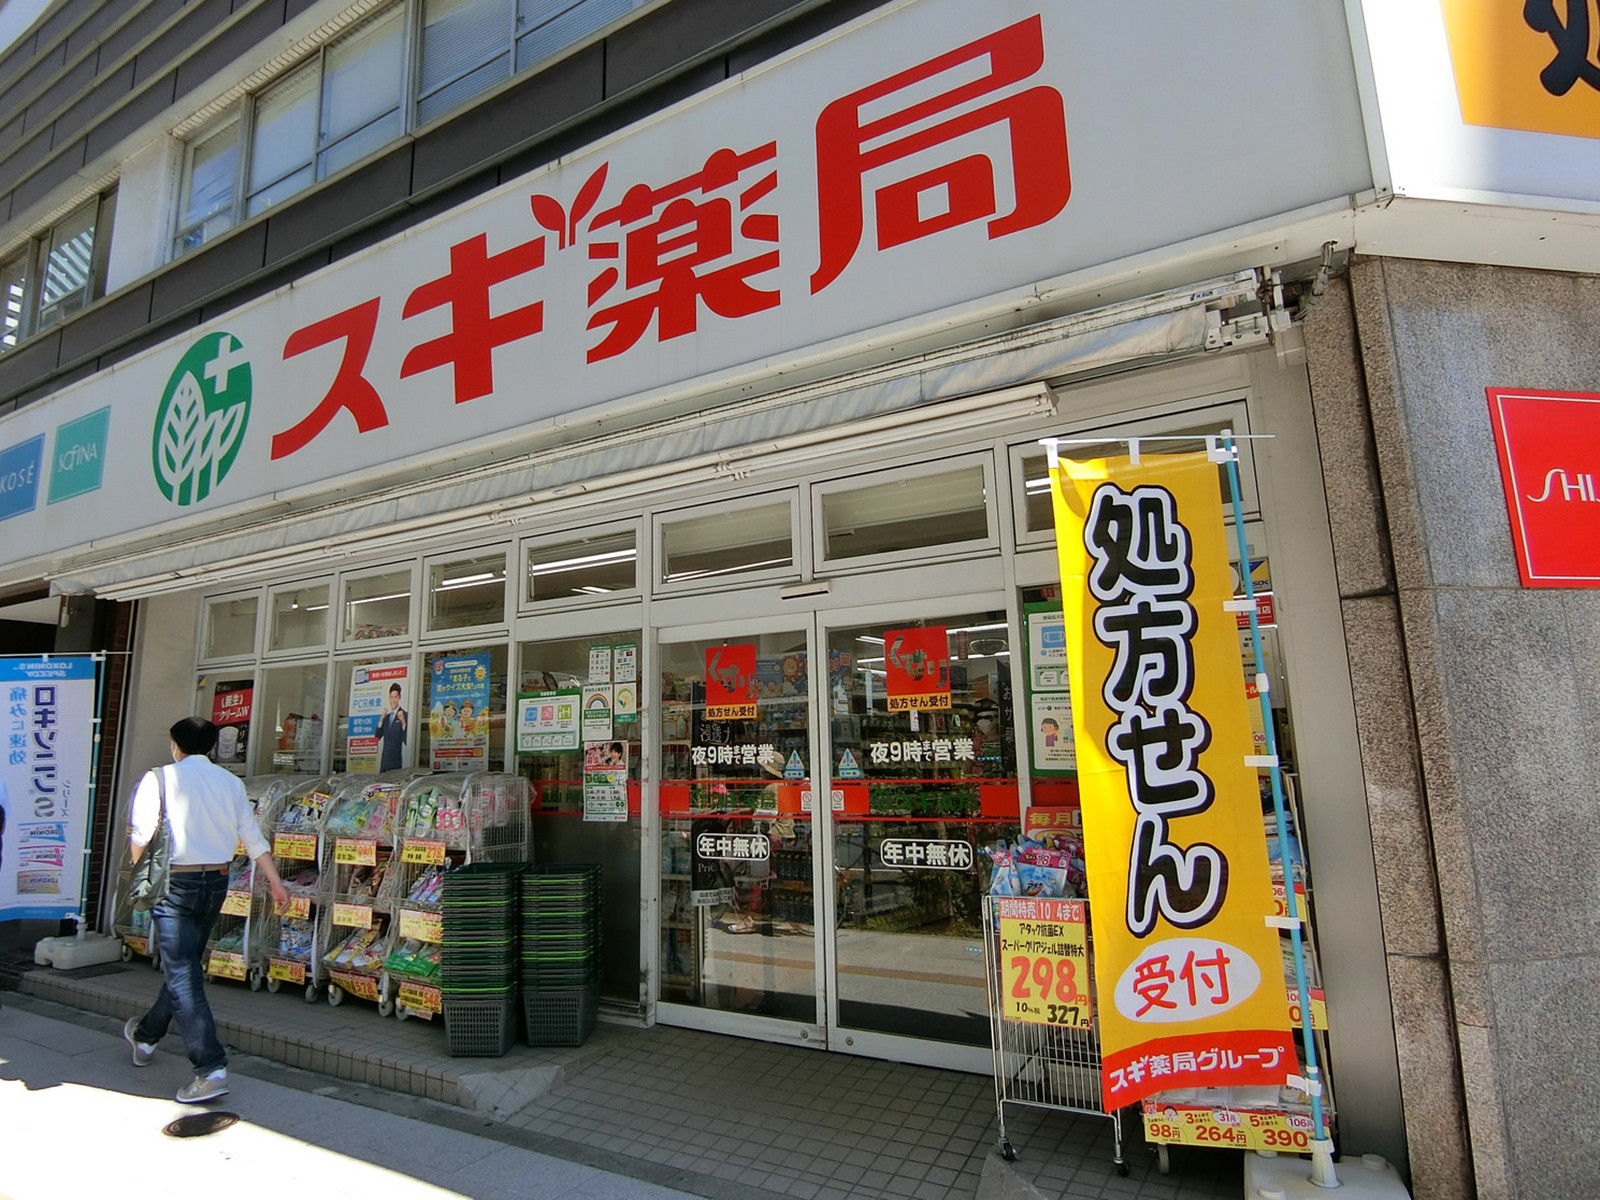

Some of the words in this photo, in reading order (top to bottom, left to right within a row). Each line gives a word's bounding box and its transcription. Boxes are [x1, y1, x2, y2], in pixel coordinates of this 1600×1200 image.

[271, 13, 1073, 461] スギ薬局
[58, 442, 98, 473] SOFINA
[0, 461, 35, 494] KOSÉ
[1527, 468, 1600, 503] SHI
[707, 705, 755, 718] 処方せん受付
[889, 695, 949, 709] 処方せん受付
[1086, 482, 1229, 938] 処方せん
[699, 836, 767, 858] 年中無休
[883, 841, 970, 867] 年中無休
[1133, 947, 1231, 1018] 受付
[1109, 1045, 1285, 1093] スギ薬局グループ
